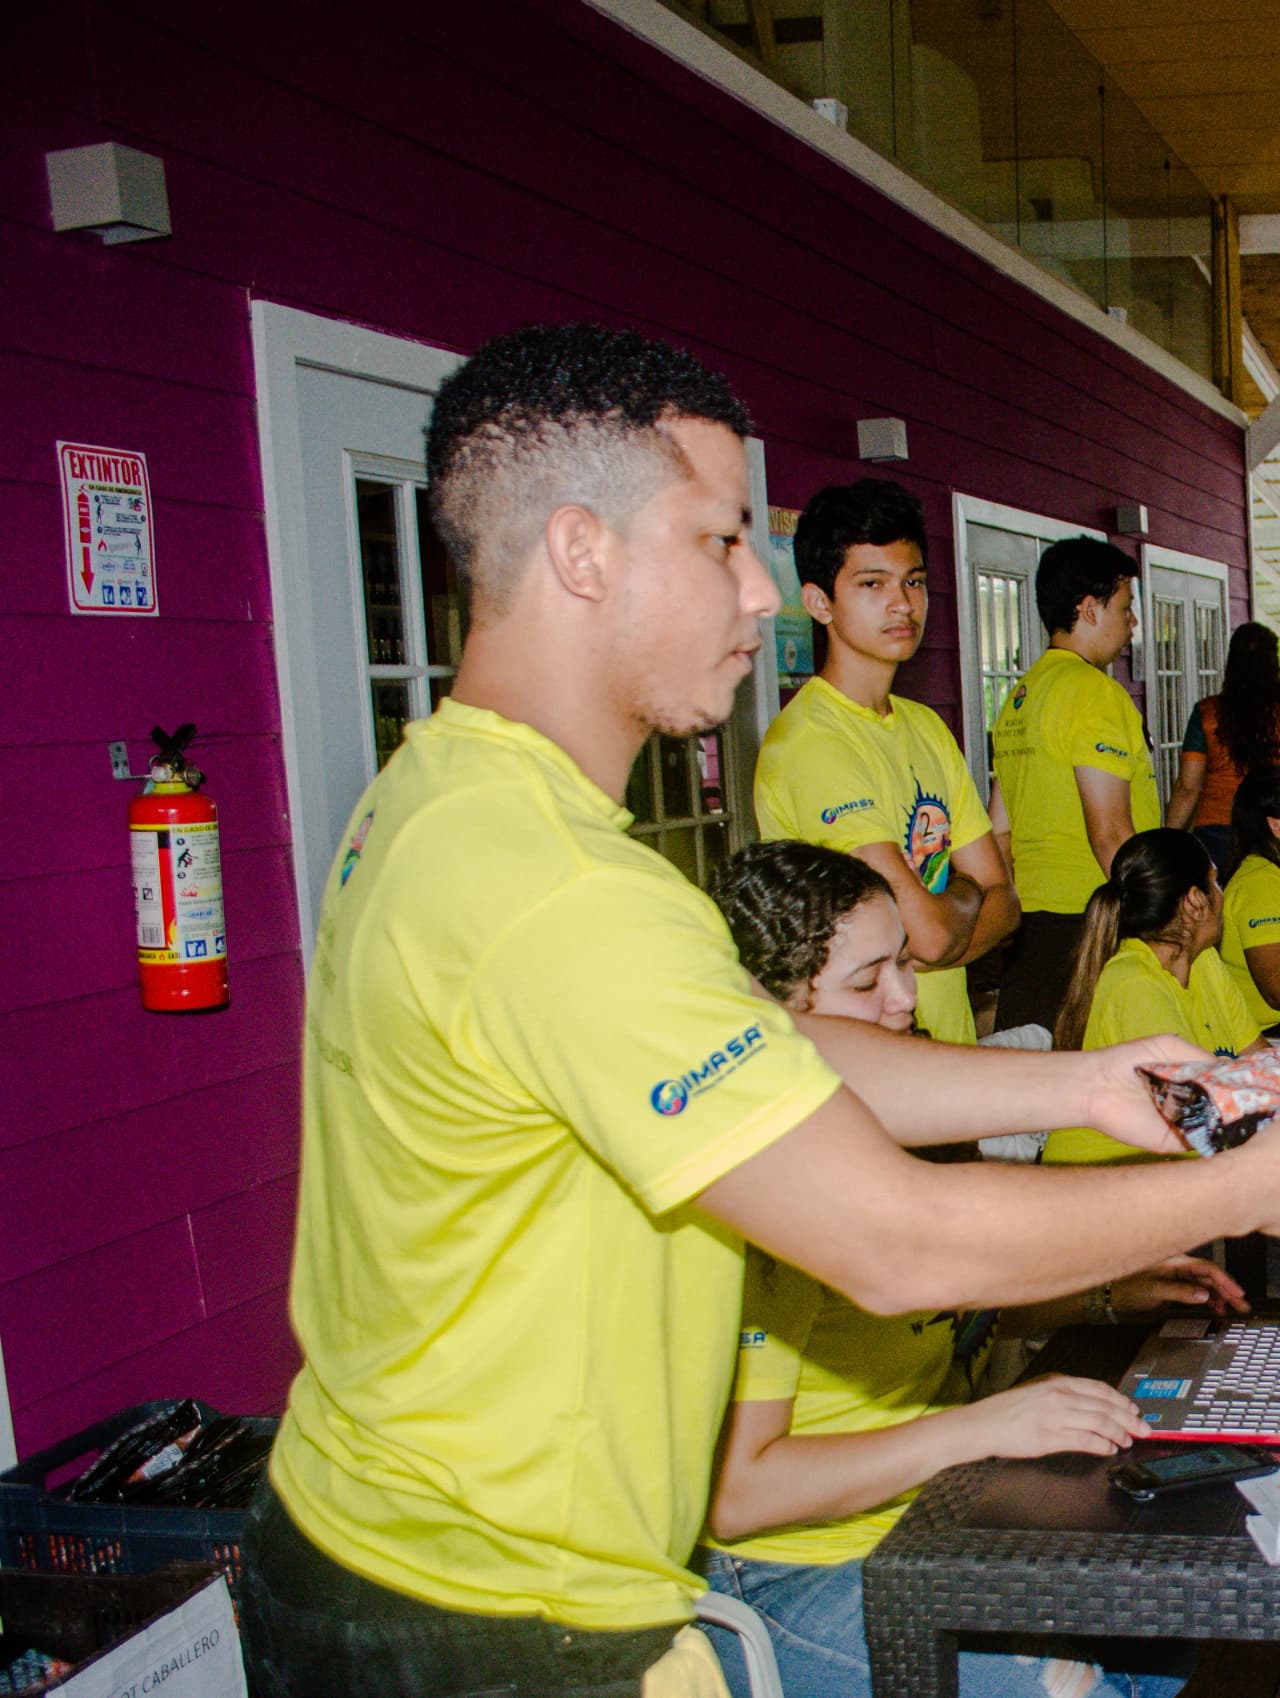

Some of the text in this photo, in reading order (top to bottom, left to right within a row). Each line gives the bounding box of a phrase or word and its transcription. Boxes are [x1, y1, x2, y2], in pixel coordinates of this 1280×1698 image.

[69, 451, 142, 486] EXTINTOR
[681, 1026, 763, 1090] IMASA
[142, 1629, 220, 1693] CABALLERO
